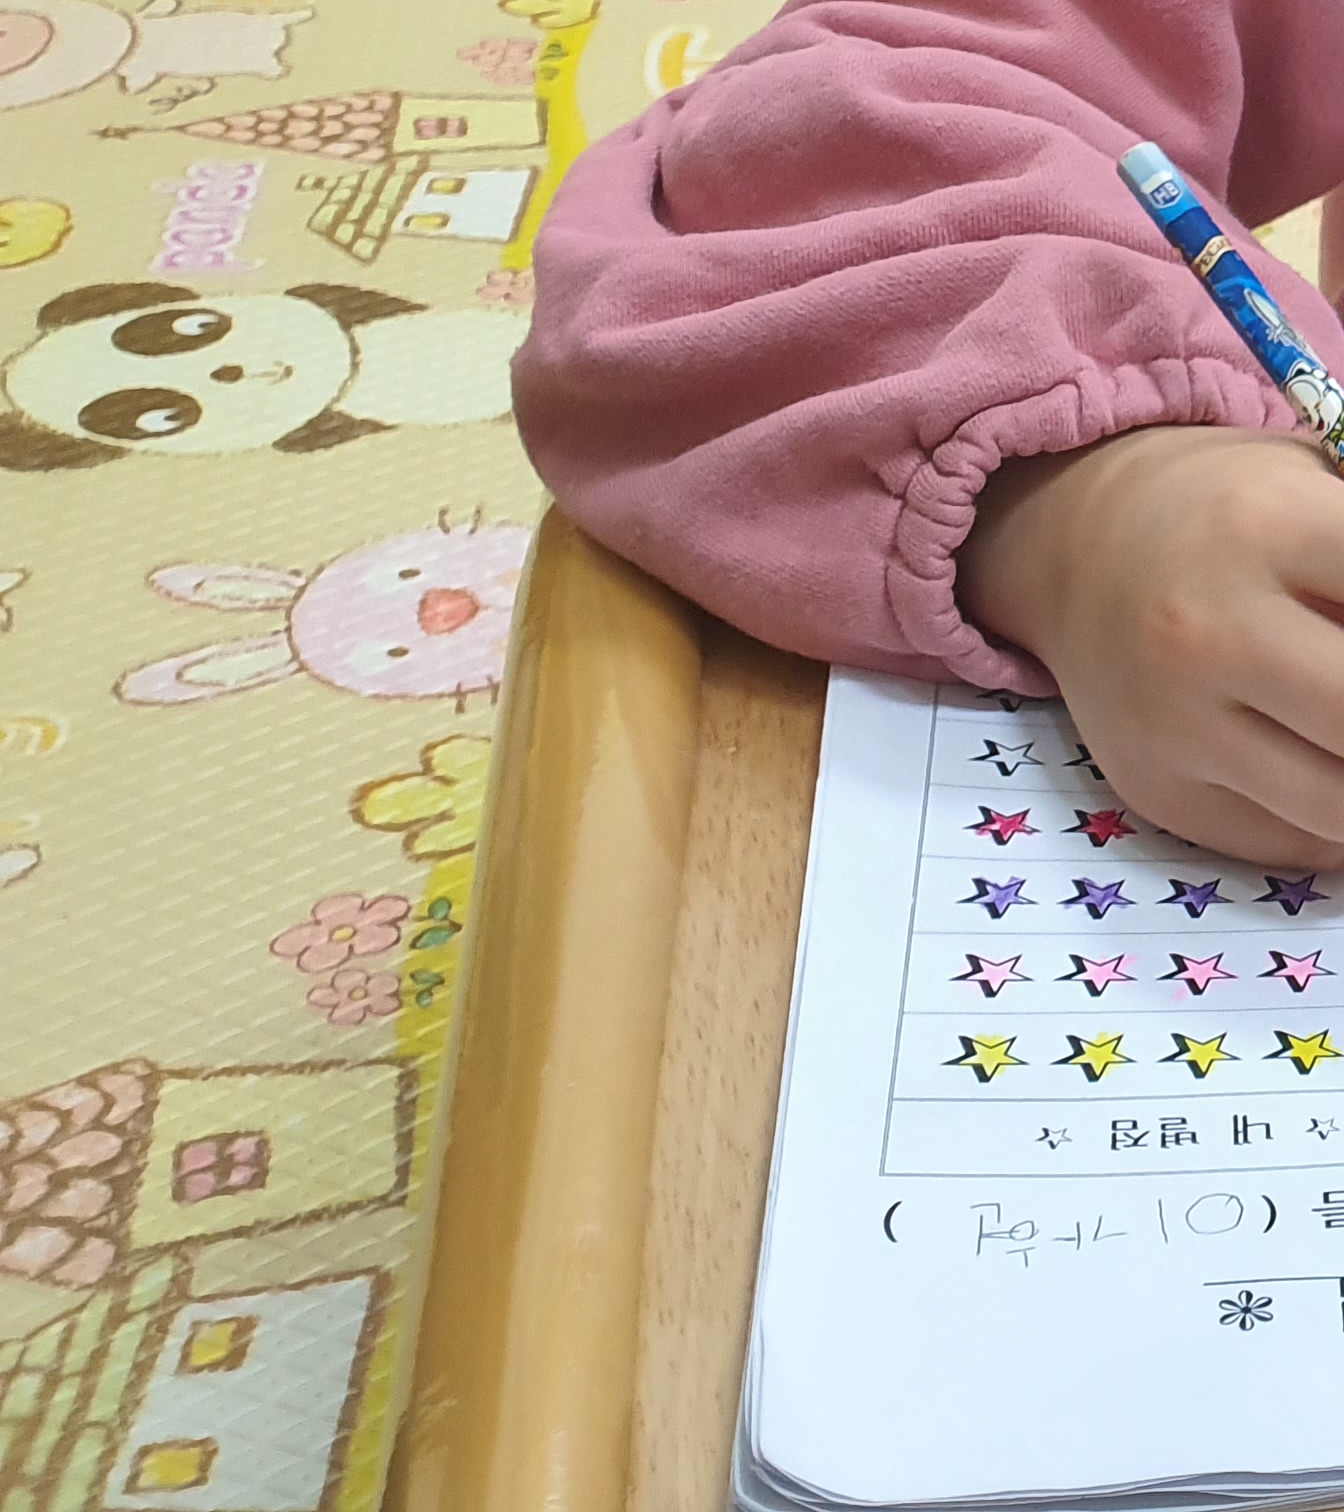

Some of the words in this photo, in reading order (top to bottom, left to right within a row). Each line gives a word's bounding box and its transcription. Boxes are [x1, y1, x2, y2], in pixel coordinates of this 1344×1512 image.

[1151, 182, 1180, 206] HB
[1109, 1116, 1198, 1151] 별점
[1230, 1113, 1273, 1146] 내
